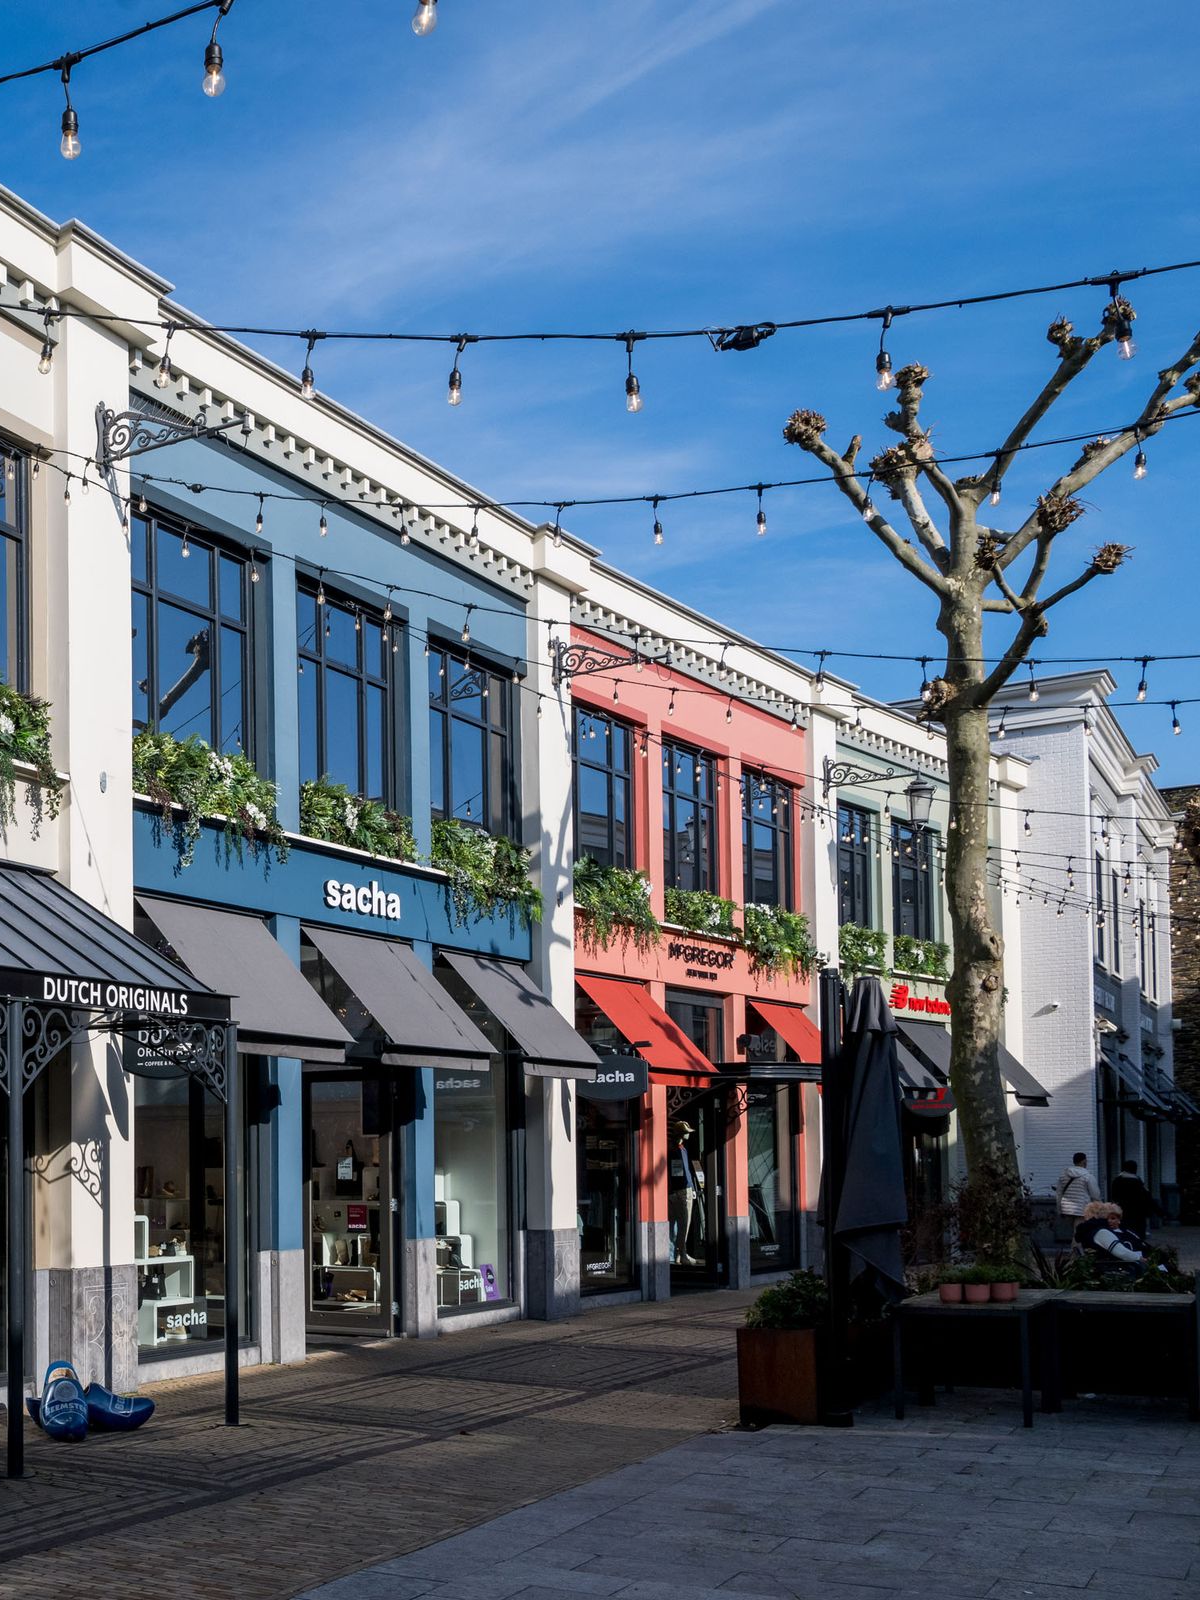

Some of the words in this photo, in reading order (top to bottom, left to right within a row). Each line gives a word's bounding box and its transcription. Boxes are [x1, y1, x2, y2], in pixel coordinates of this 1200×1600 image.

[325, 880, 400, 919] sacha
[43, 977, 101, 1005] DUTCH
[106, 985, 188, 1014] ORIGINALS
[588, 1070, 634, 1083] acha
[459, 1275, 484, 1291] sacha
[167, 1309, 207, 1328] sacha
